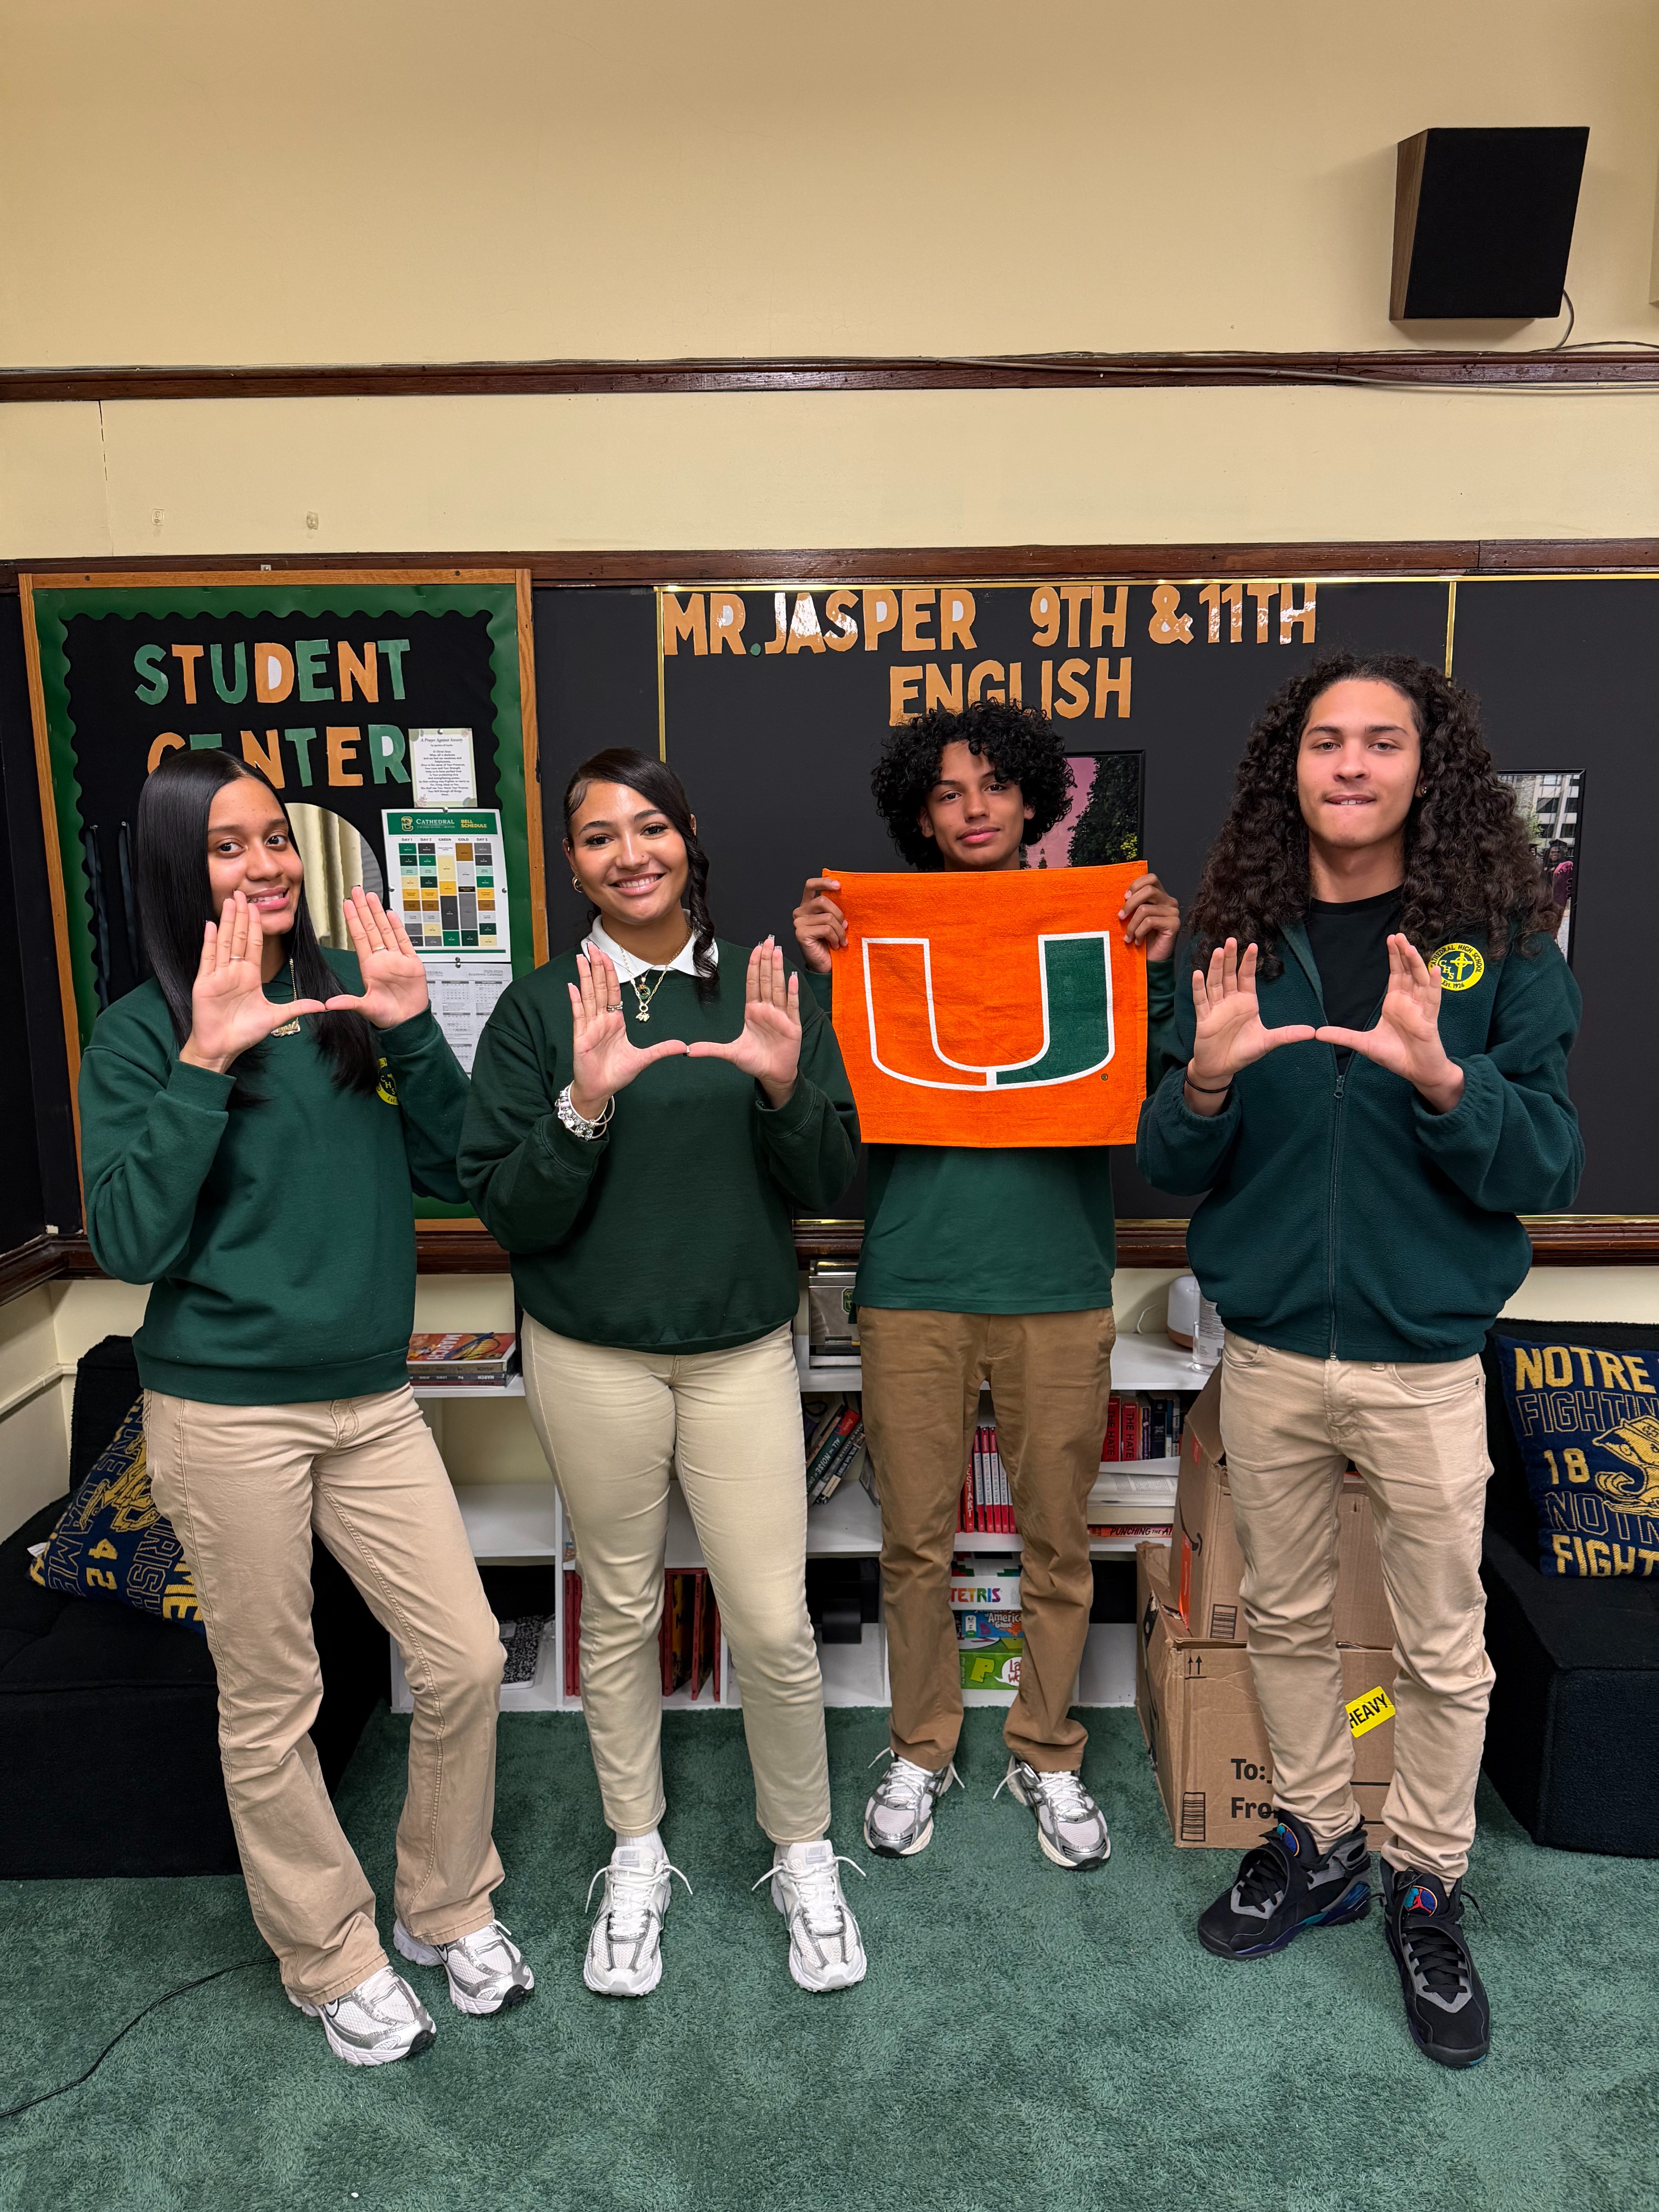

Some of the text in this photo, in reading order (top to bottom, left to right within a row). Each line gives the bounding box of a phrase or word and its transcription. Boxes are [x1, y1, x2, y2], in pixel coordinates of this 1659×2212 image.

[765, 589, 977, 654] JASPER
[1030, 586, 1128, 648] 9TH
[1149, 584, 1194, 645] &
[1199, 583, 1317, 645] 11TH
[134, 639, 410, 705] STUDENT
[890, 657, 1132, 726] ENGLISH
[147, 724, 411, 789] CNTER
[1430, 945, 1482, 973] CATHEDRAL HIGH SCHOOL
[1439, 960, 1455, 980] CHS
[861, 930, 1115, 1091] U
[427, 1334, 462, 1360] MARCH
[1514, 1346, 1657, 1394] NOTRE
[1108, 1410, 1116, 1427] THE
[1107, 1431, 1115, 1455] HATE
[1125, 1413, 1135, 1458] THE HATE
[815, 1453, 831, 1475] NOISE
[1543, 1448, 1590, 1486] 18
[1110, 1527, 1151, 1536] PUNCHING
[950, 1588, 1001, 1602] TETRIS
[1349, 1693, 1388, 1729] HEAVY
[1231, 1759, 1265, 1780] To:
[1231, 1797, 1278, 1819] Fro
